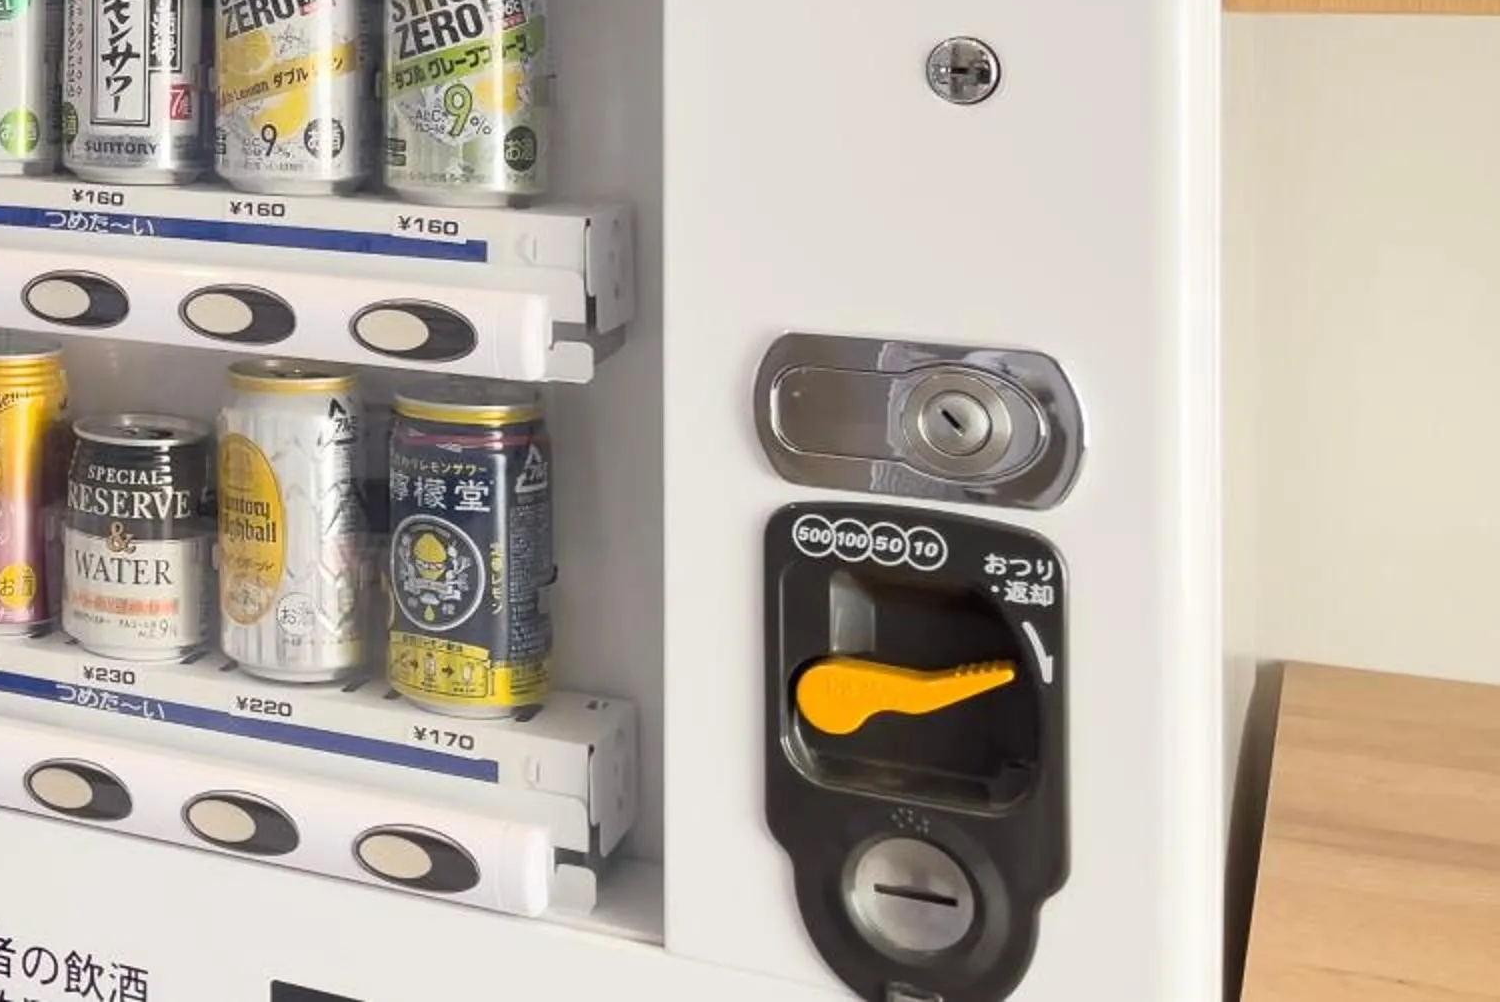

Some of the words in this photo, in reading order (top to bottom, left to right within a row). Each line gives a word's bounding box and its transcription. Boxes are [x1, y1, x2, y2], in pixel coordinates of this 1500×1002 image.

[395, 0, 485, 61] ZERO
[84, 137, 158, 156] SUNTORY
[72, 189, 125, 206] ¥160
[230, 201, 286, 218] ¥160
[397, 216, 459, 237] ¥160
[87, 464, 165, 485] SPECIAL
[67, 486, 192, 520] RESERVE
[105, 521, 137, 554] &
[799, 528, 832, 545] 500
[836, 530, 868, 549] 100
[874, 535, 904, 554] 50
[914, 540, 939, 559] 10
[74, 548, 174, 586] WATER
[983, 553, 1054, 581] おつり
[83, 665, 136, 685] ¥230
[236, 696, 292, 718] ¥220
[413, 725, 475, 751] ¥170
